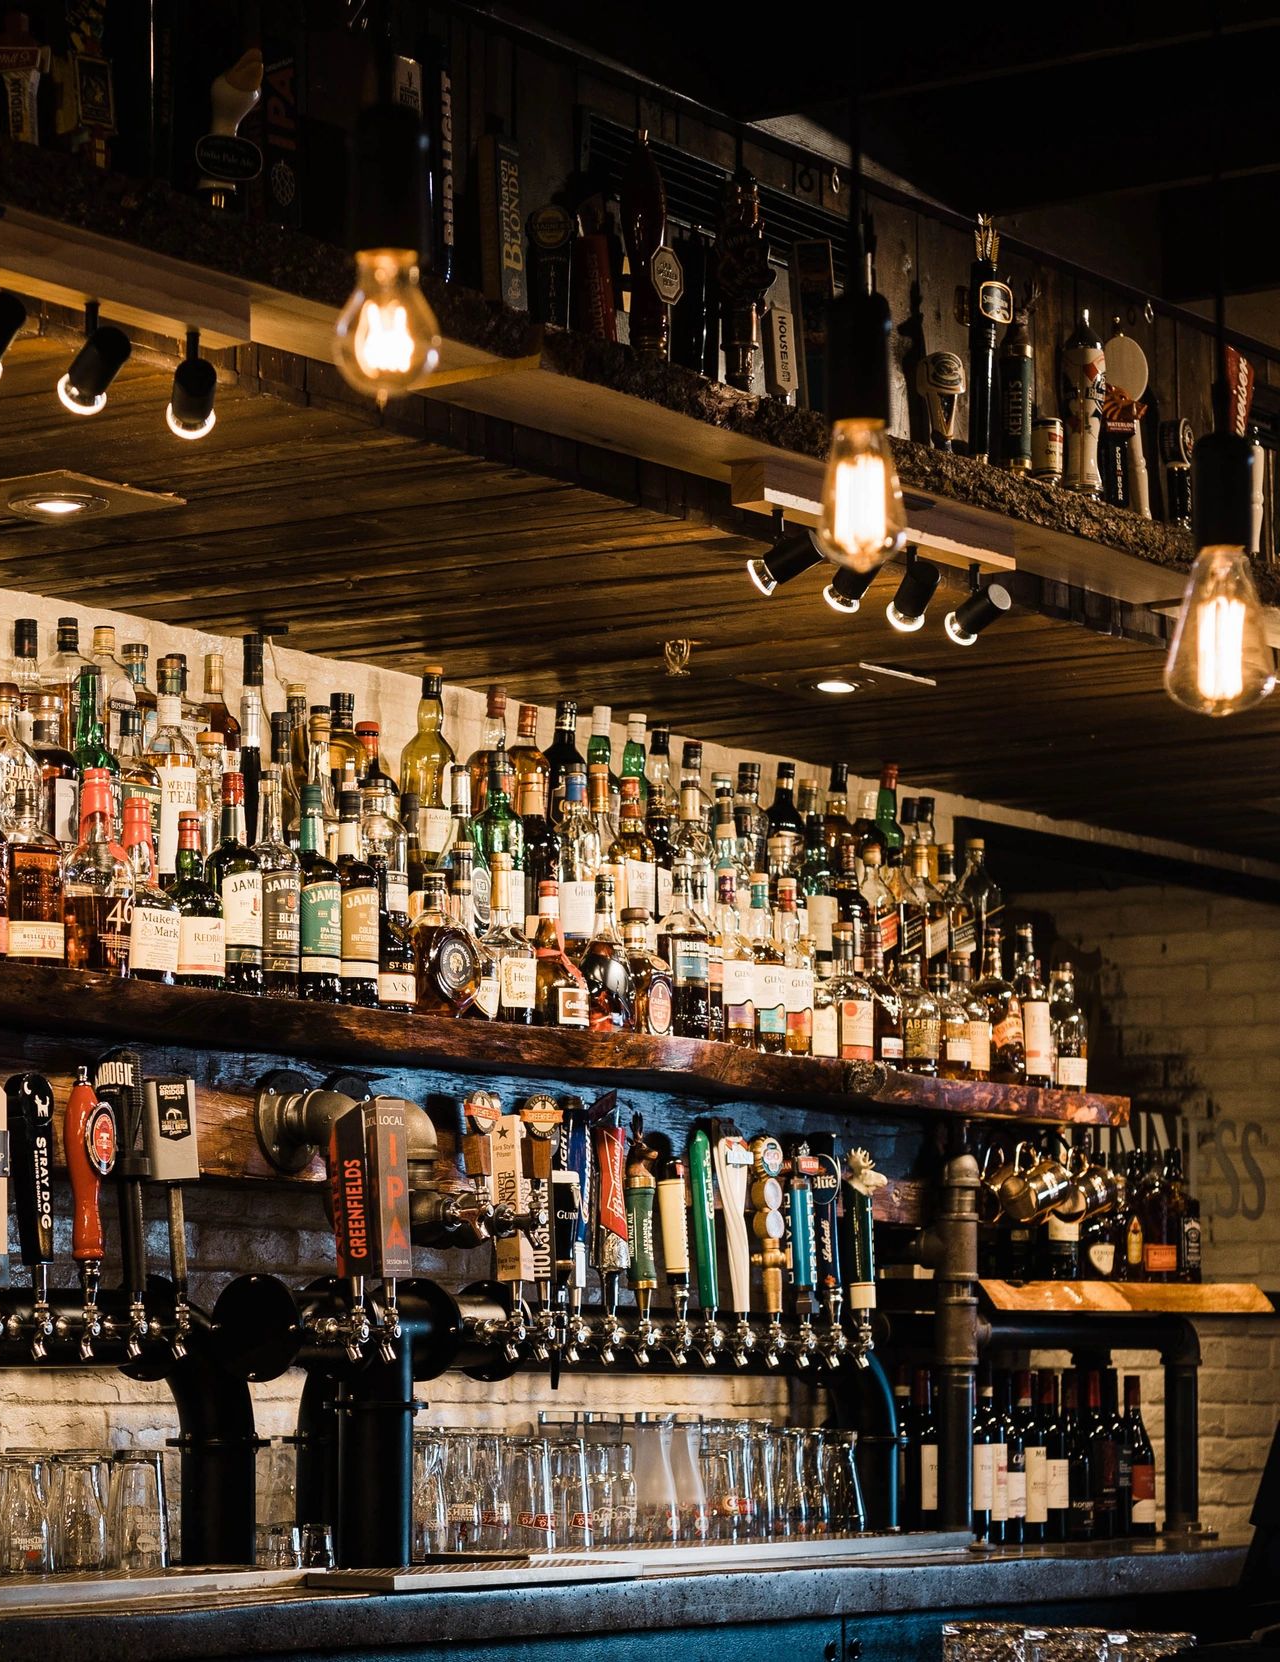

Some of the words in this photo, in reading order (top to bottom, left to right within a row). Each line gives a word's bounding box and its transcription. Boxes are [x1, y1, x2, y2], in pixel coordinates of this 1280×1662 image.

[778, 315, 789, 362] HOUSE
[1233, 356, 1250, 438] weiser
[1009, 379, 1023, 436] KEITH'S
[4, 763, 35, 779] ELIJAH
[167, 780, 197, 790] WRITE
[167, 790, 197, 804] TEAR
[231, 878, 261, 893] JAME
[265, 878, 300, 893] JAMES
[309, 887, 341, 904] JAMES
[346, 894, 379, 909] JAMES
[141, 911, 179, 926] Maker's
[279, 913, 300, 923] BLAC
[154, 925, 179, 938] Mark
[194, 932, 223, 943] REDBR
[277, 929, 300, 940] BARR
[40, 938, 56, 949] 10
[392, 983, 414, 992] VSO
[906, 1018, 941, 1030] ABERFE
[379, 1115, 405, 1126] LOCAL
[503, 1143, 515, 1151] Style
[560, 1125, 568, 1172] LIGHT
[35, 1136, 50, 1181] STRAY
[611, 1140, 624, 1220] Budweiser
[35, 1180, 43, 1213] COMPANY
[386, 1133, 408, 1249] IPA
[40, 1184, 52, 1230] DOG
[344, 1159, 368, 1260] GREENFIELDS
[806, 1191, 816, 1253] CLEAR
[821, 1219, 831, 1263] Labatt
[533, 1223, 551, 1279] HOUSE
